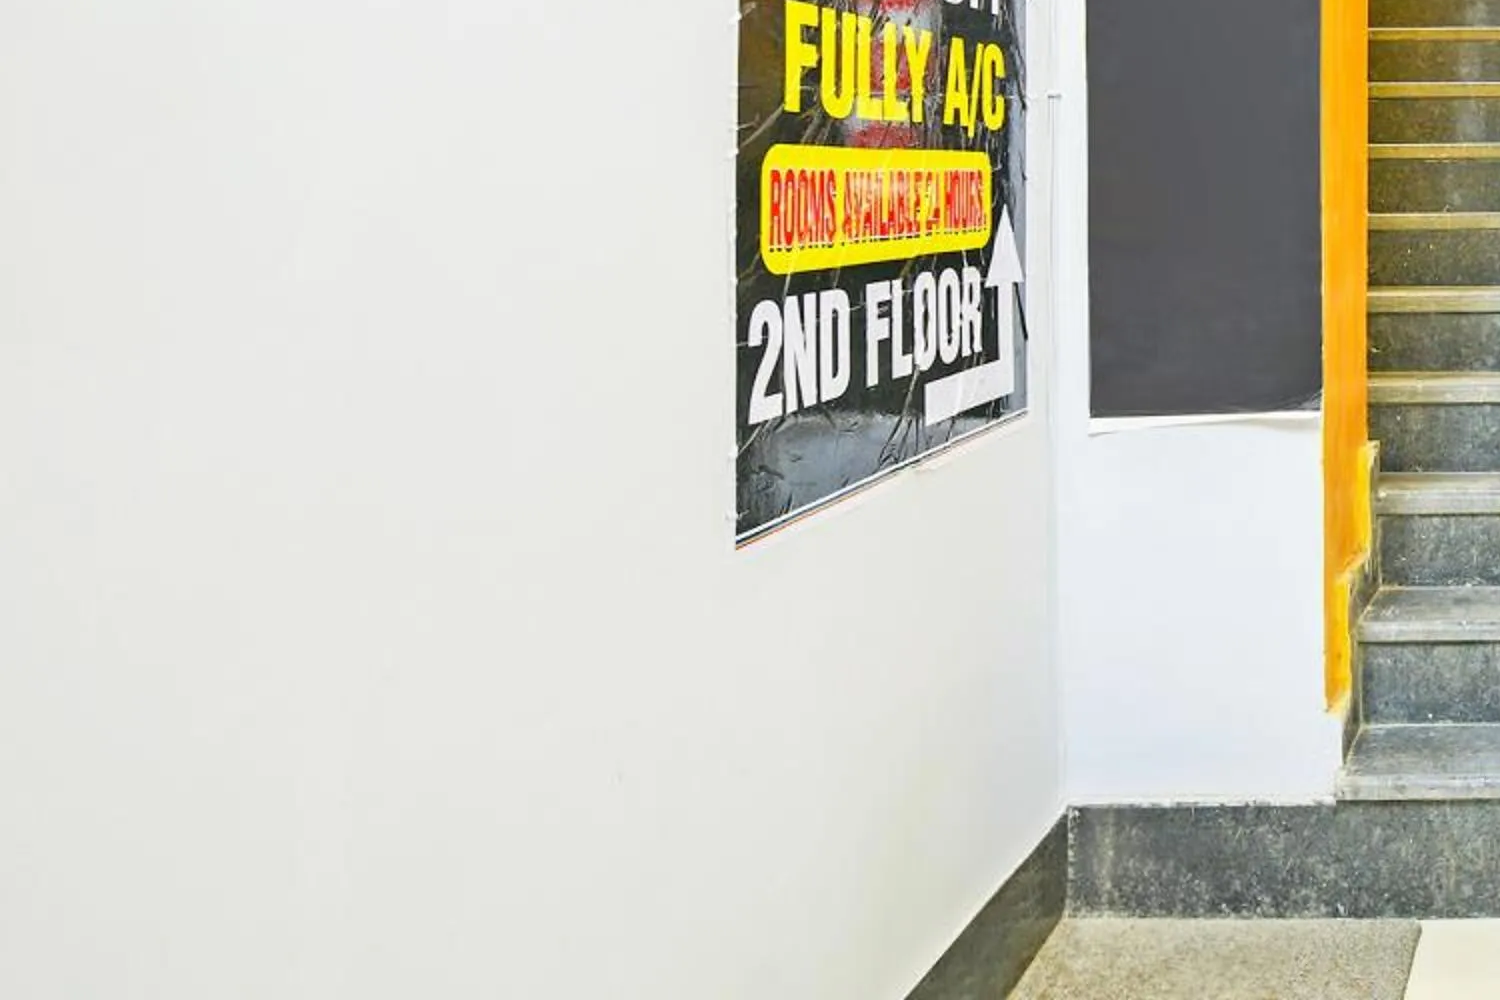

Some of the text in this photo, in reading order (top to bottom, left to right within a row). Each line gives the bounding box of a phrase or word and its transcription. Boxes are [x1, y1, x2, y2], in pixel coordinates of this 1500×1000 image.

[943, 36, 1006, 139] A/C
[769, 168, 836, 252] ROOMS
[748, 265, 983, 426] 2ND FLOOR
